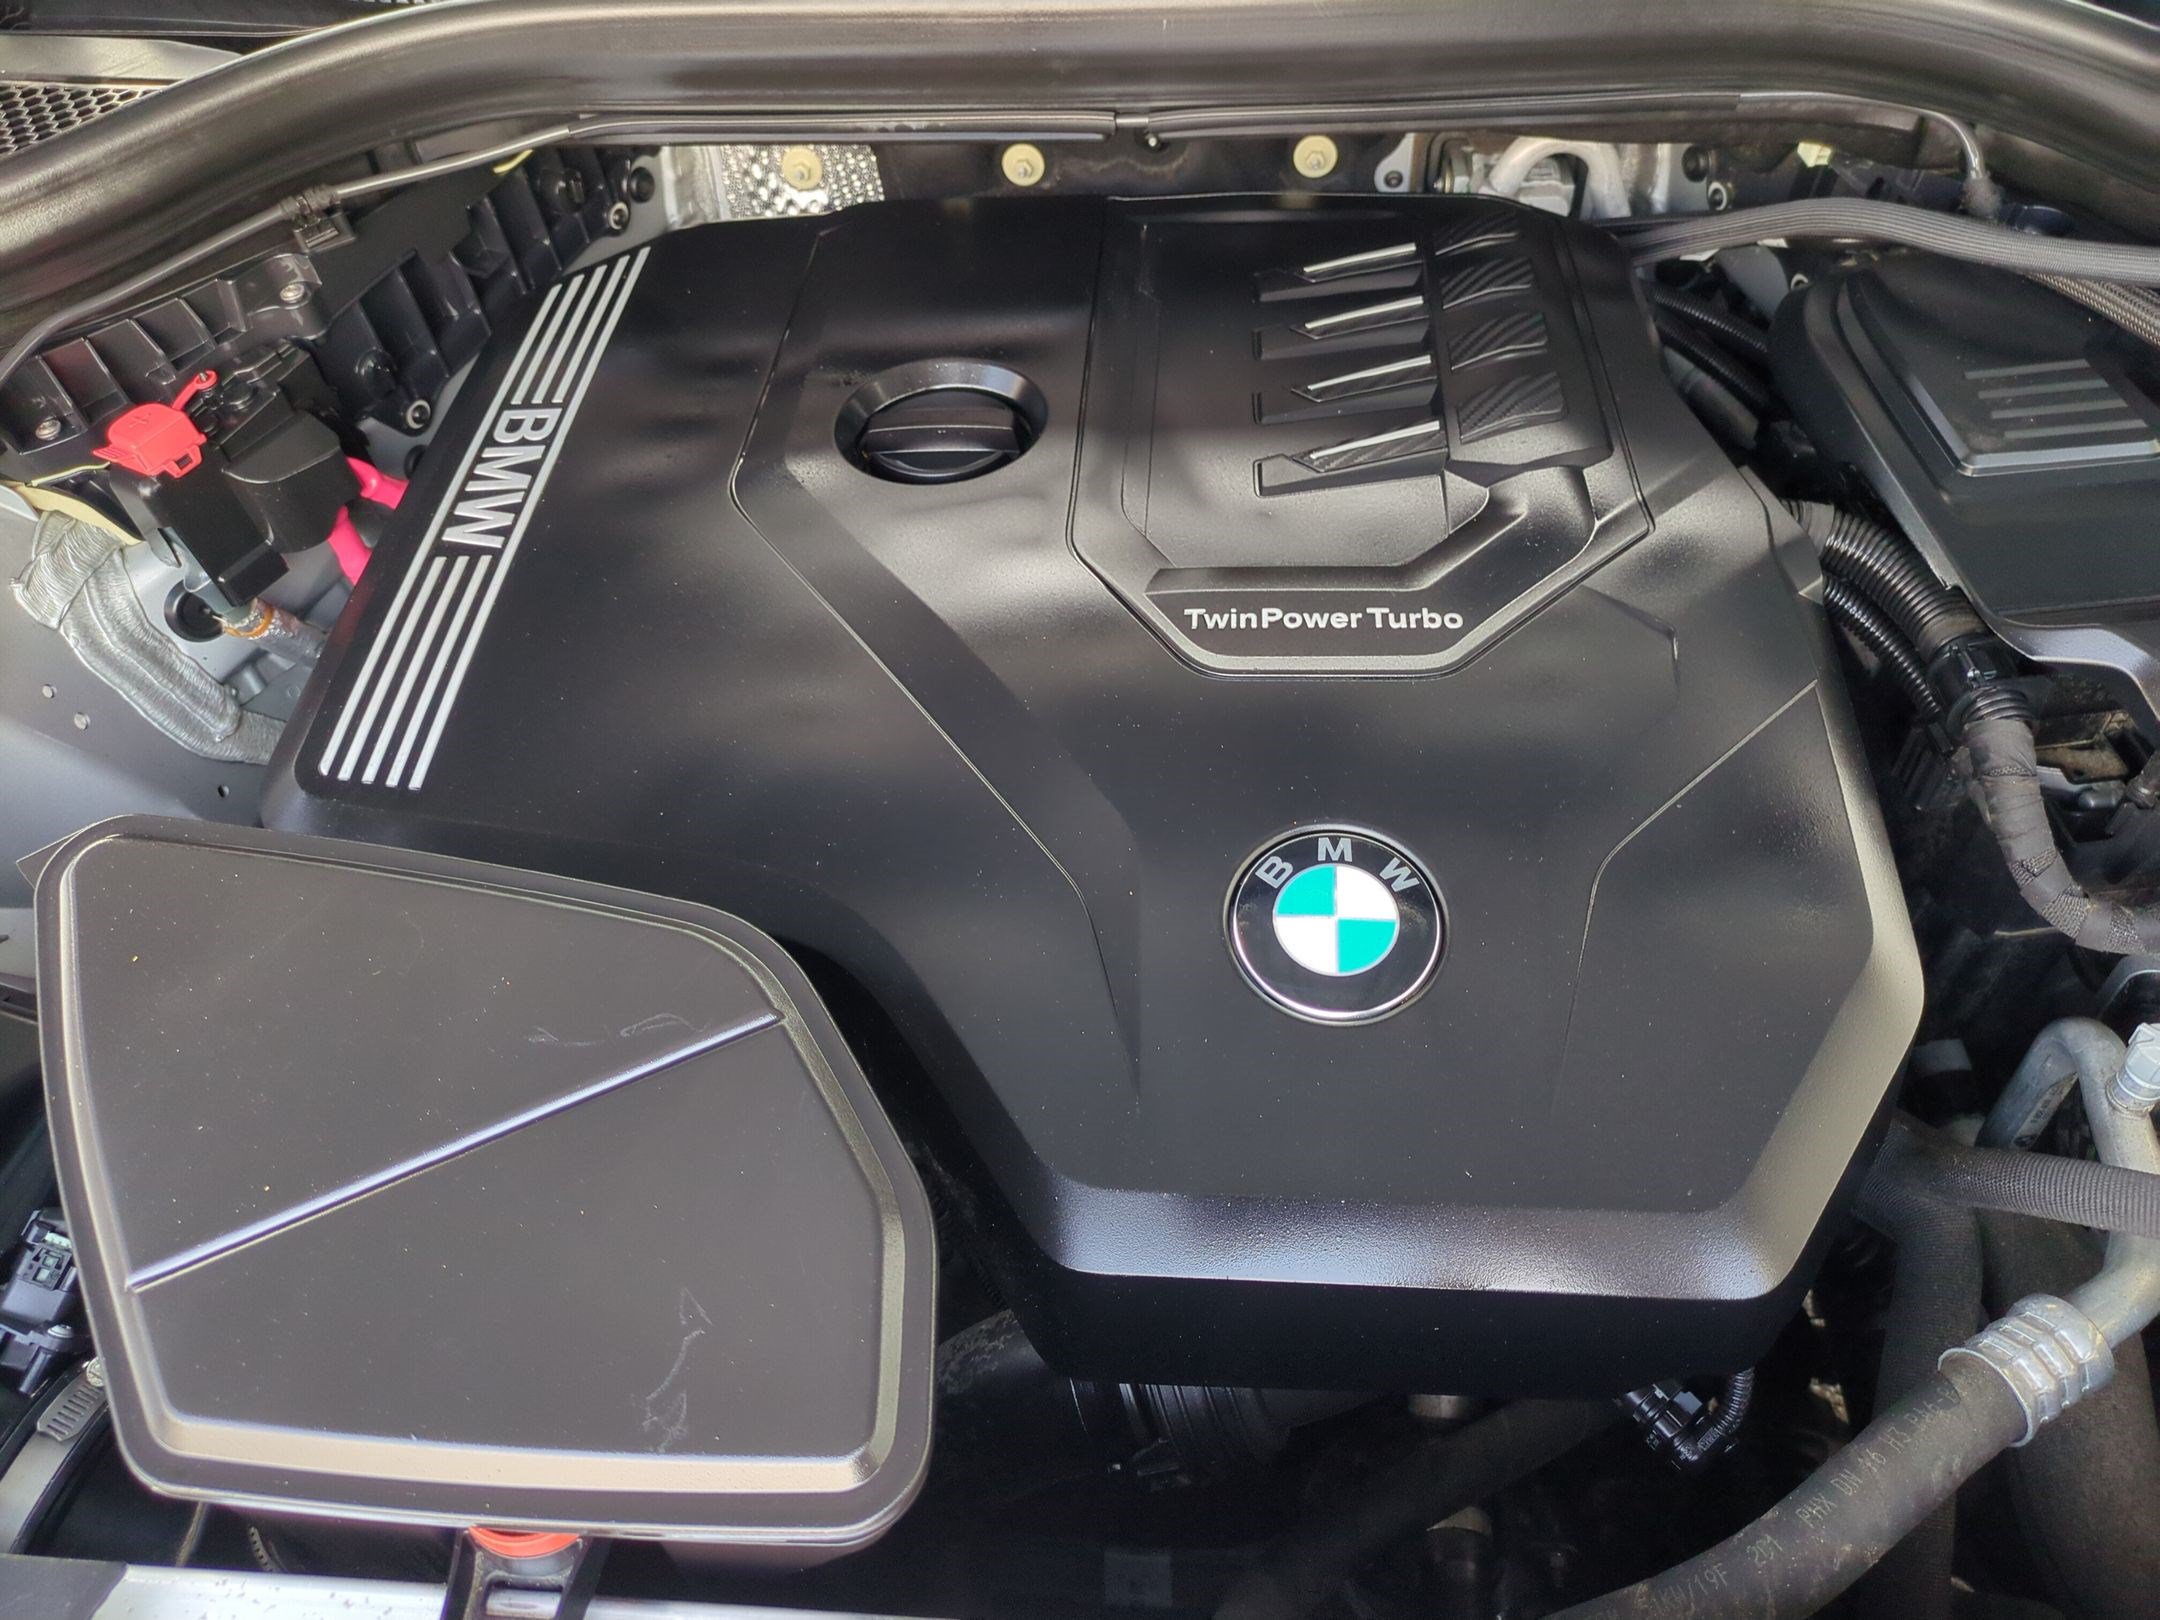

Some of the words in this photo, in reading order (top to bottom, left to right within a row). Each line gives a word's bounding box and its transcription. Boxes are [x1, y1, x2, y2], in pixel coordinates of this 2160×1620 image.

[440, 407, 563, 549] BMW
[1365, 607, 1464, 630] Turbo
[1255, 837, 1420, 893] BMW
